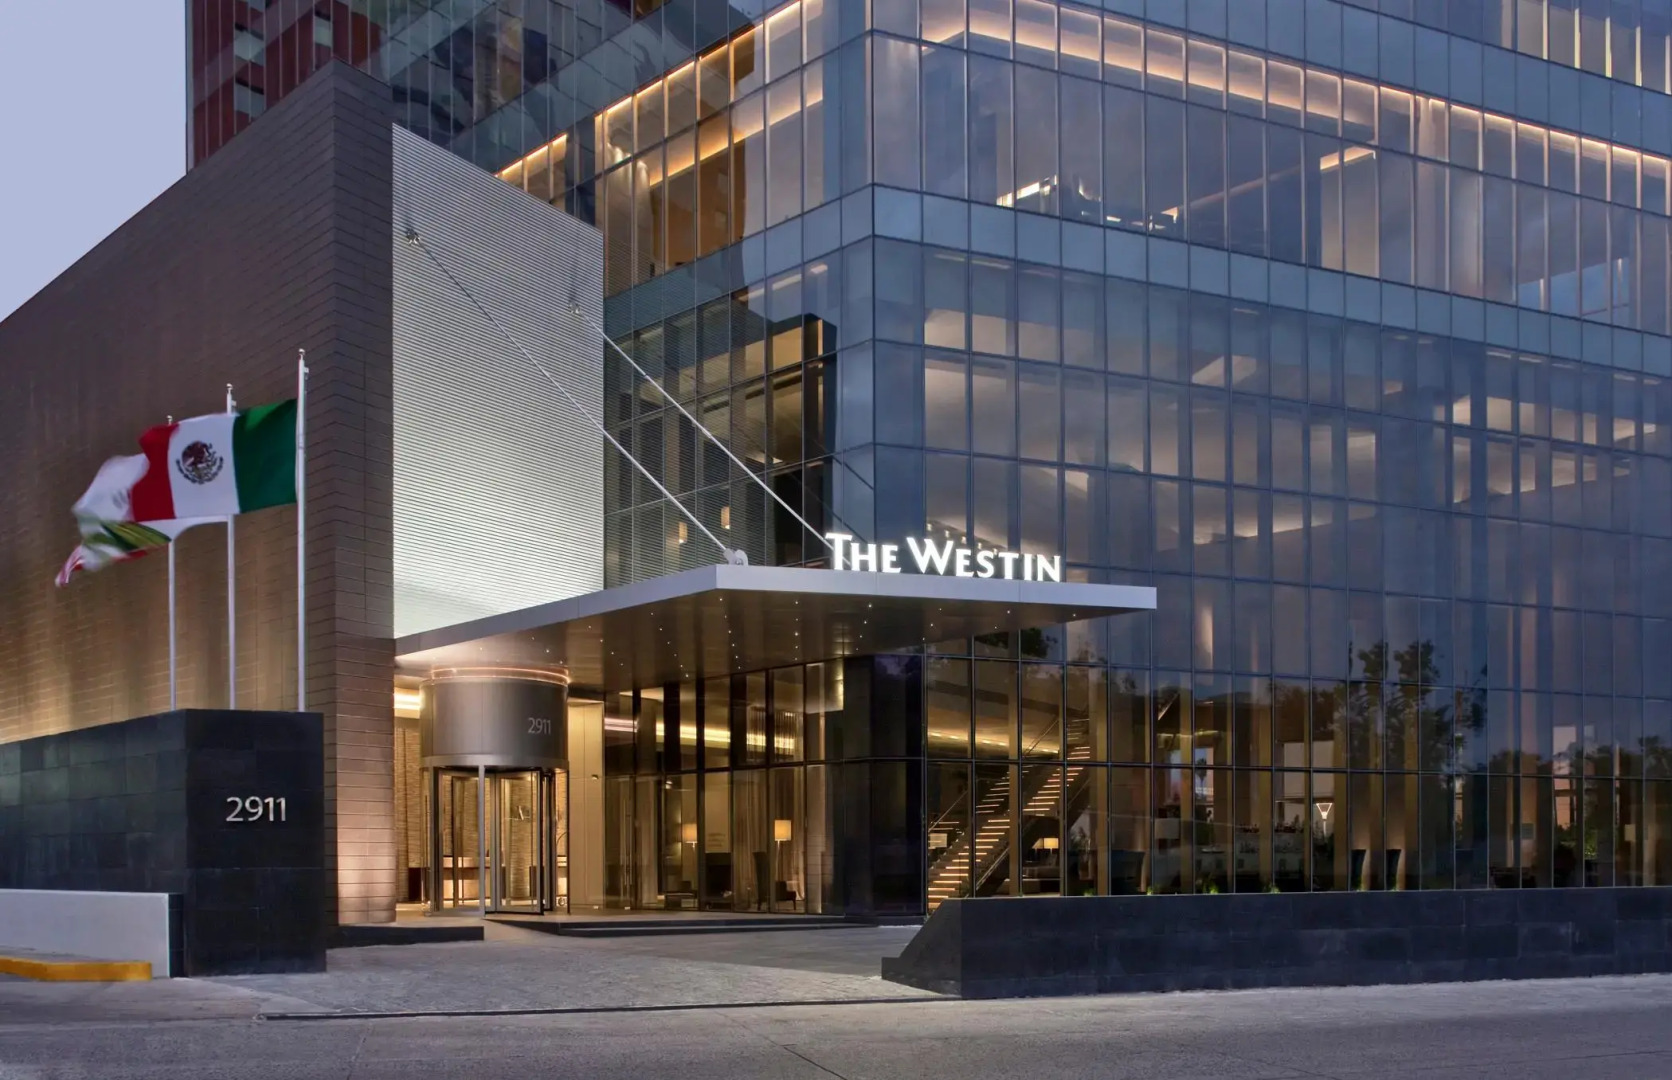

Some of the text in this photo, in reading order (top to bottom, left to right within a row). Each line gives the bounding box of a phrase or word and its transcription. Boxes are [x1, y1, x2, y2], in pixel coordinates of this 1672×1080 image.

[825, 532, 1061, 582] THE WESTIN
[528, 717, 551, 735] 2911
[226, 796, 286, 822] 2911
